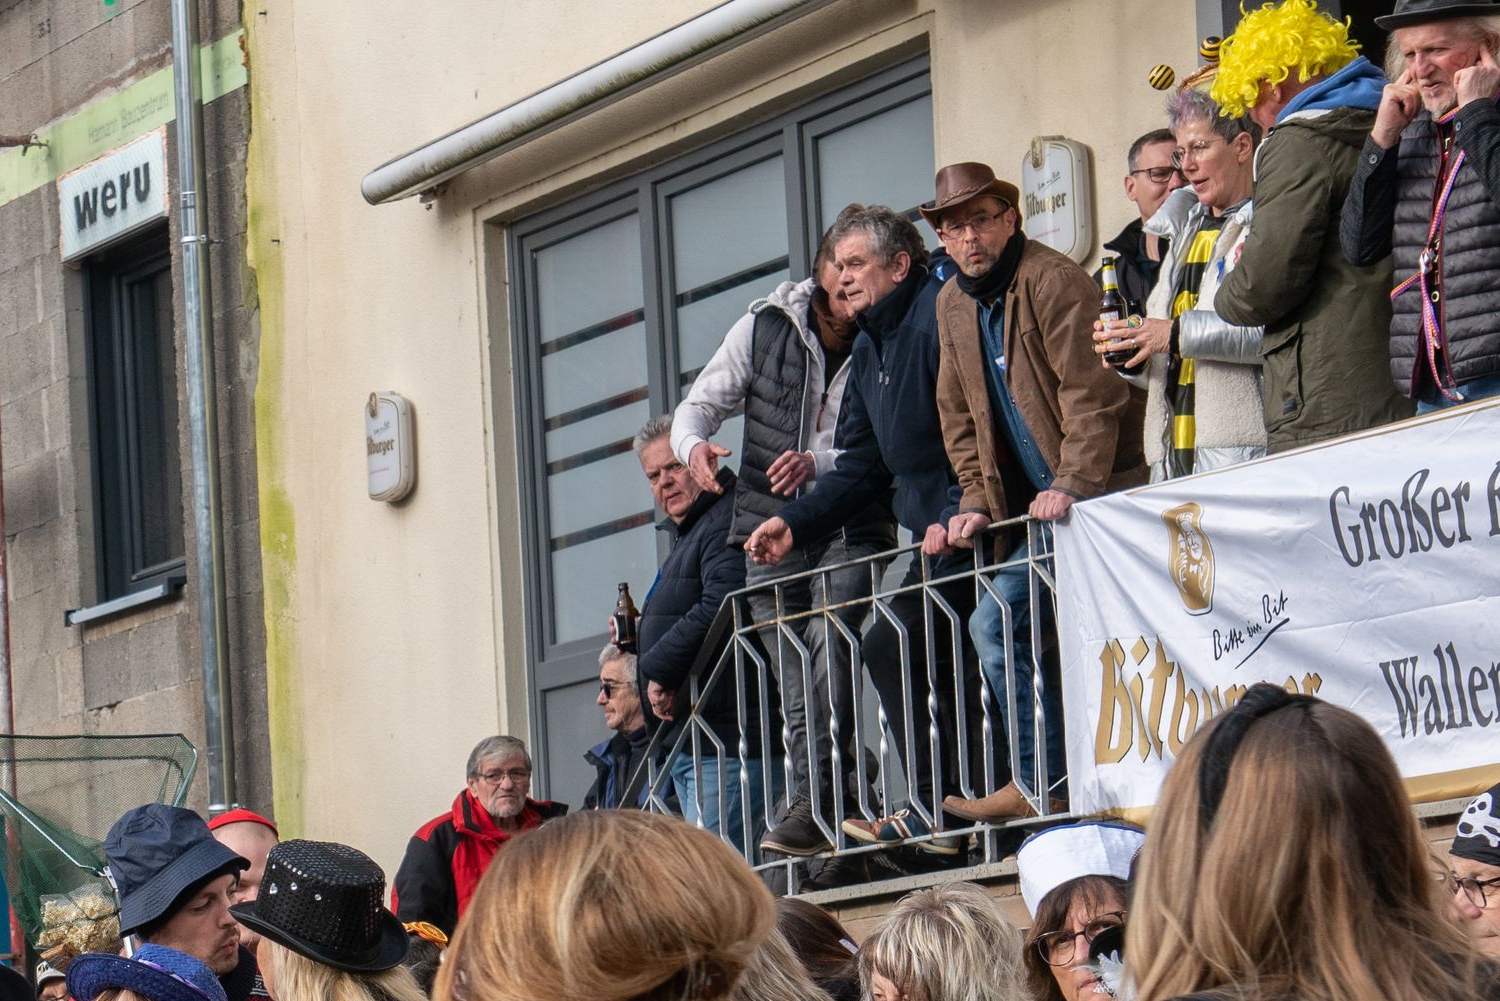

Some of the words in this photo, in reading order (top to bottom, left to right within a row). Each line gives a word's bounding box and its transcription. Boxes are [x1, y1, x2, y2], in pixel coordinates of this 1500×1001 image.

[74, 161, 151, 232] weru
[1329, 468, 1472, 567] Großer
[1213, 628, 1245, 661] Bitte
[1262, 590, 1288, 624] Bit
